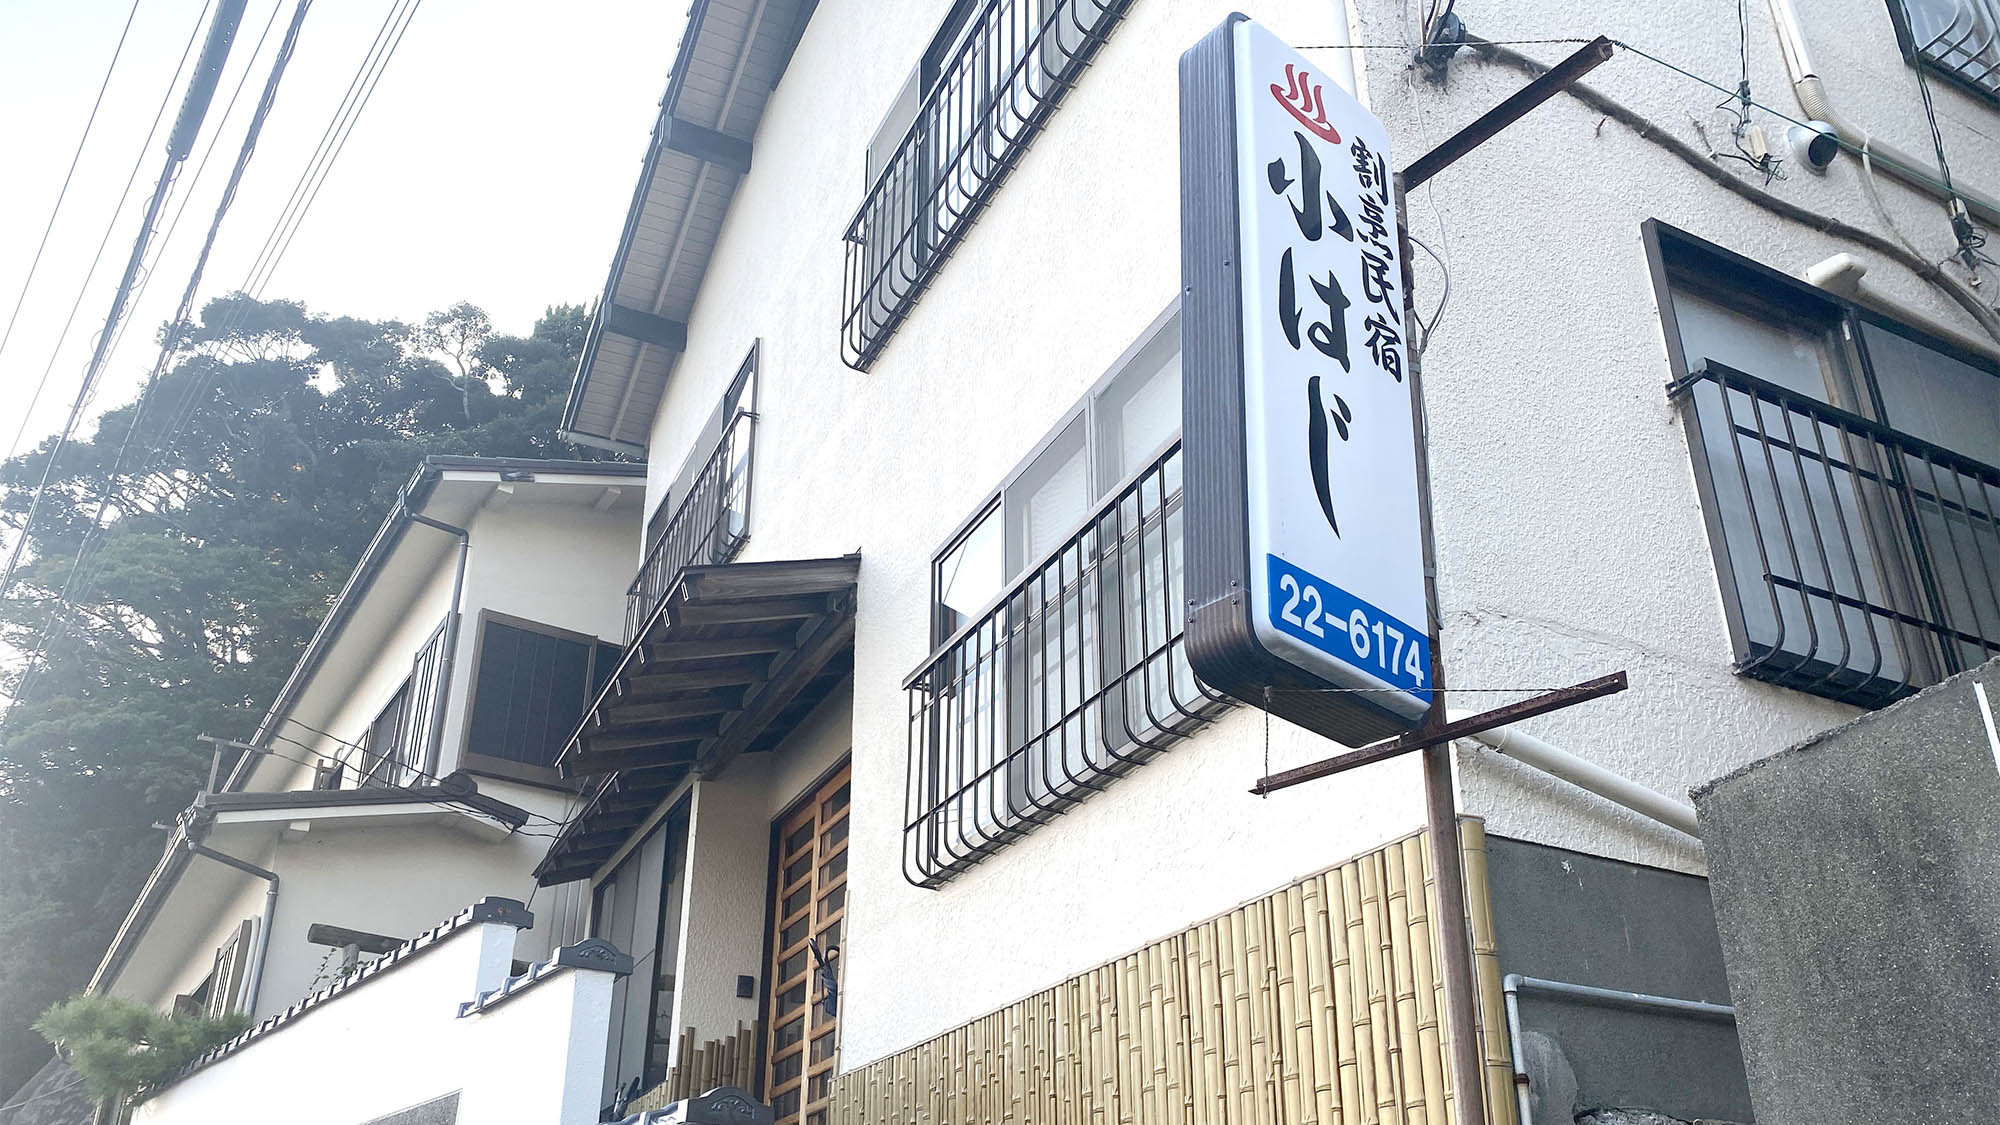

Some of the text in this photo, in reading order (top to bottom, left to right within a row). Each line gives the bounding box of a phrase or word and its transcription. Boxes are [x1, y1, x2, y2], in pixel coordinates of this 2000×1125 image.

[1267, 130, 1354, 540] 小はじ
[1350, 136, 1402, 383] 割烹民宿
[1279, 573, 1425, 687] 22-6174
